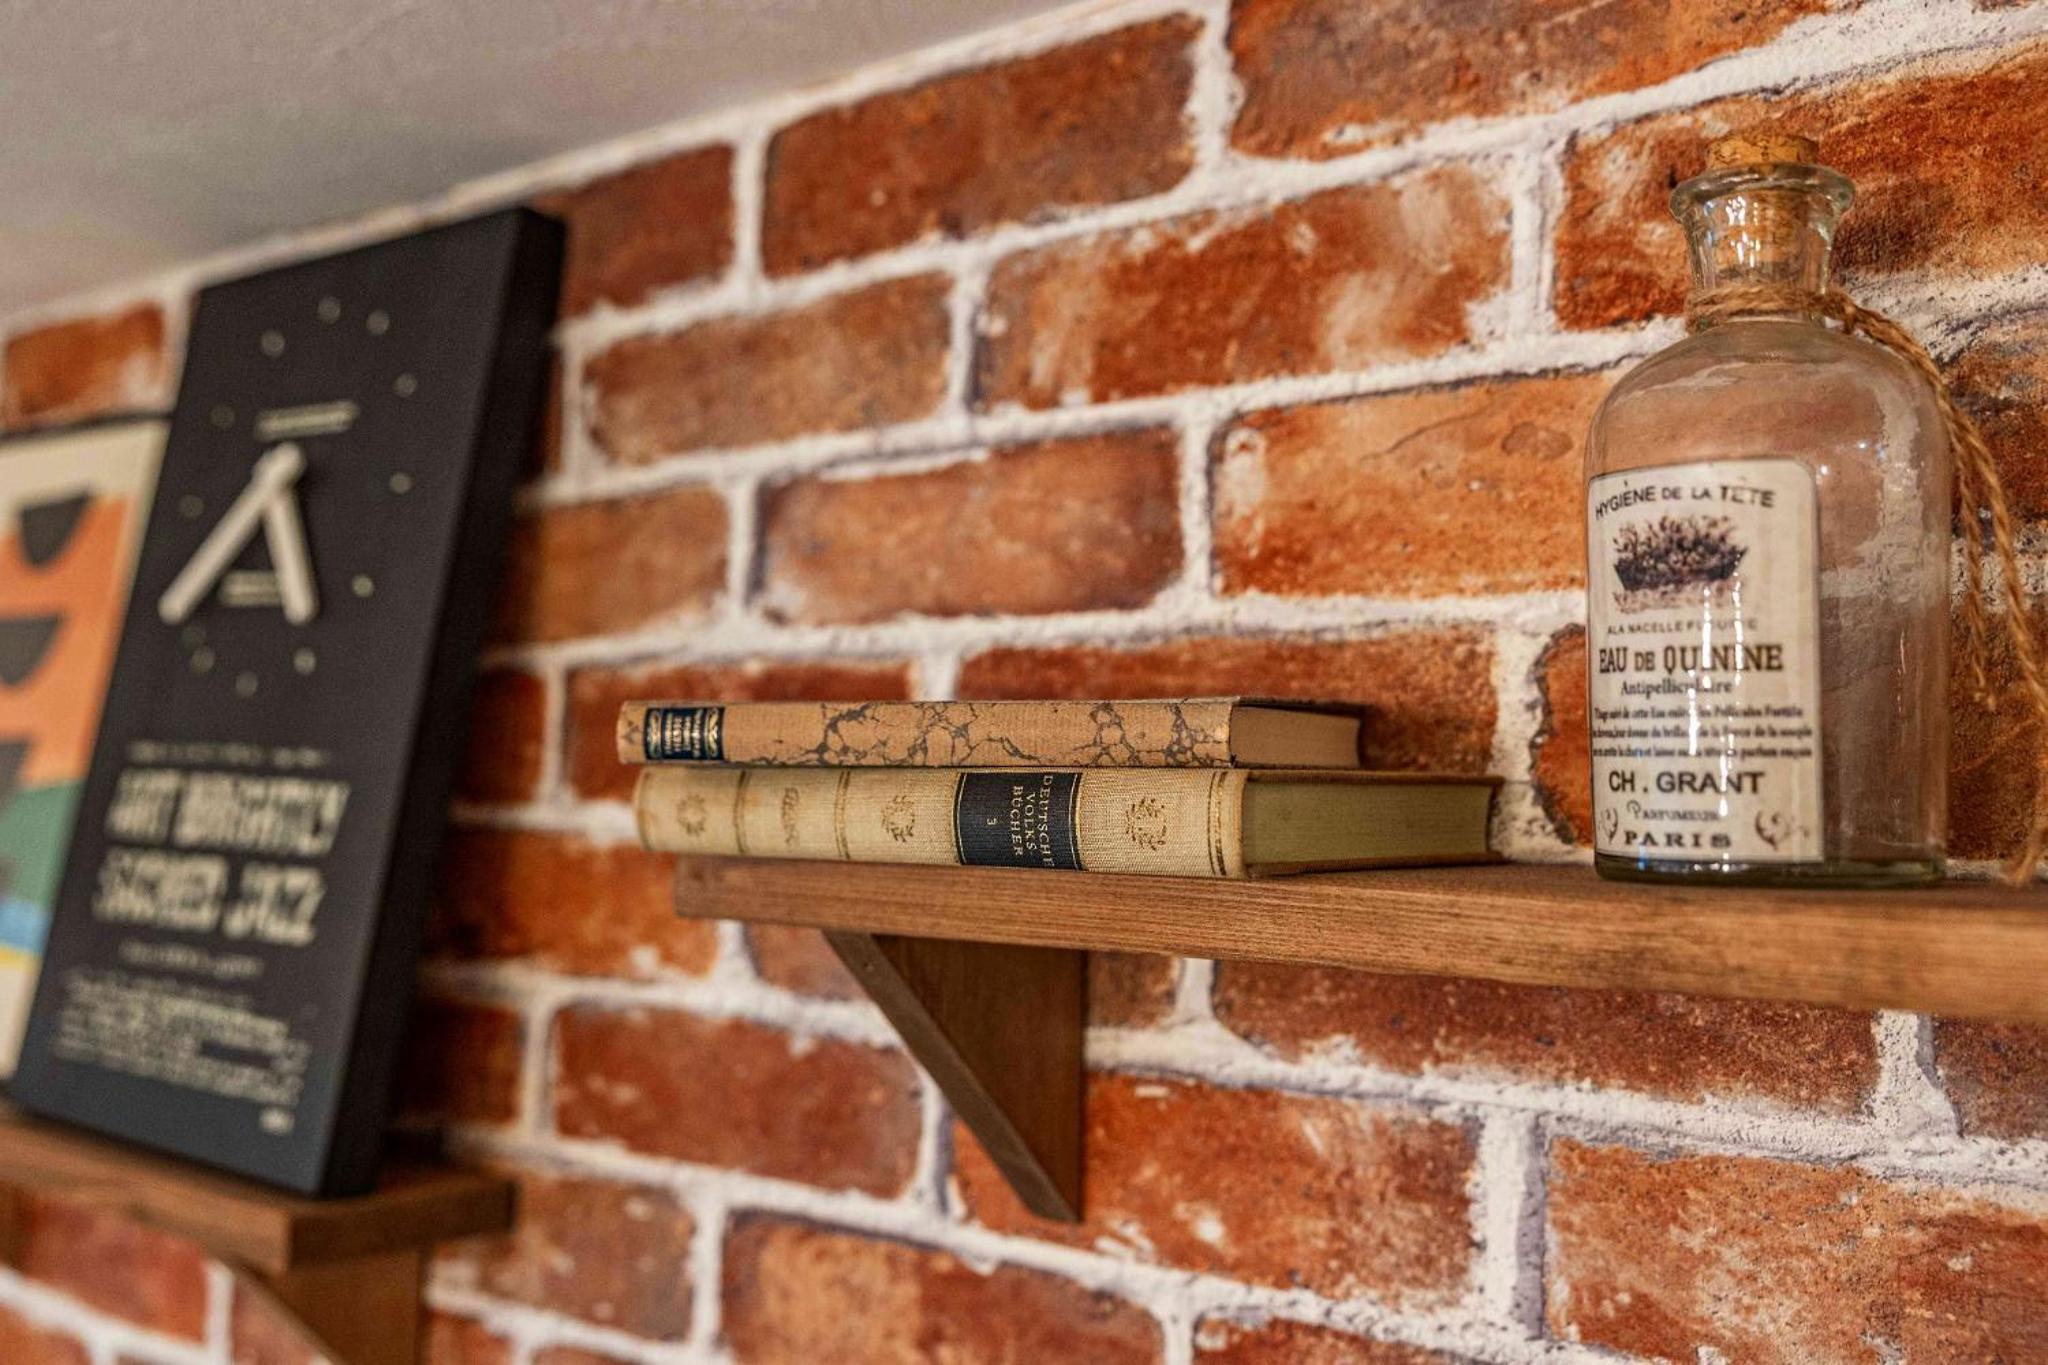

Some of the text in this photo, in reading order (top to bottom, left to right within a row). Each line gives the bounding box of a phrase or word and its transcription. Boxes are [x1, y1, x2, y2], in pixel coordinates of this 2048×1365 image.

[1662, 486, 1681, 500] DE
[1691, 486, 1712, 500] LA
[1628, 620, 1682, 633] NACELLE
[1599, 643, 1783, 675] EAU DE QUNNE
[1656, 770, 1766, 794] GRANT
[986, 817, 997, 826] 3
[1037, 774, 1055, 867] DEUTSCHE
[1624, 829, 1731, 848] PARIS
